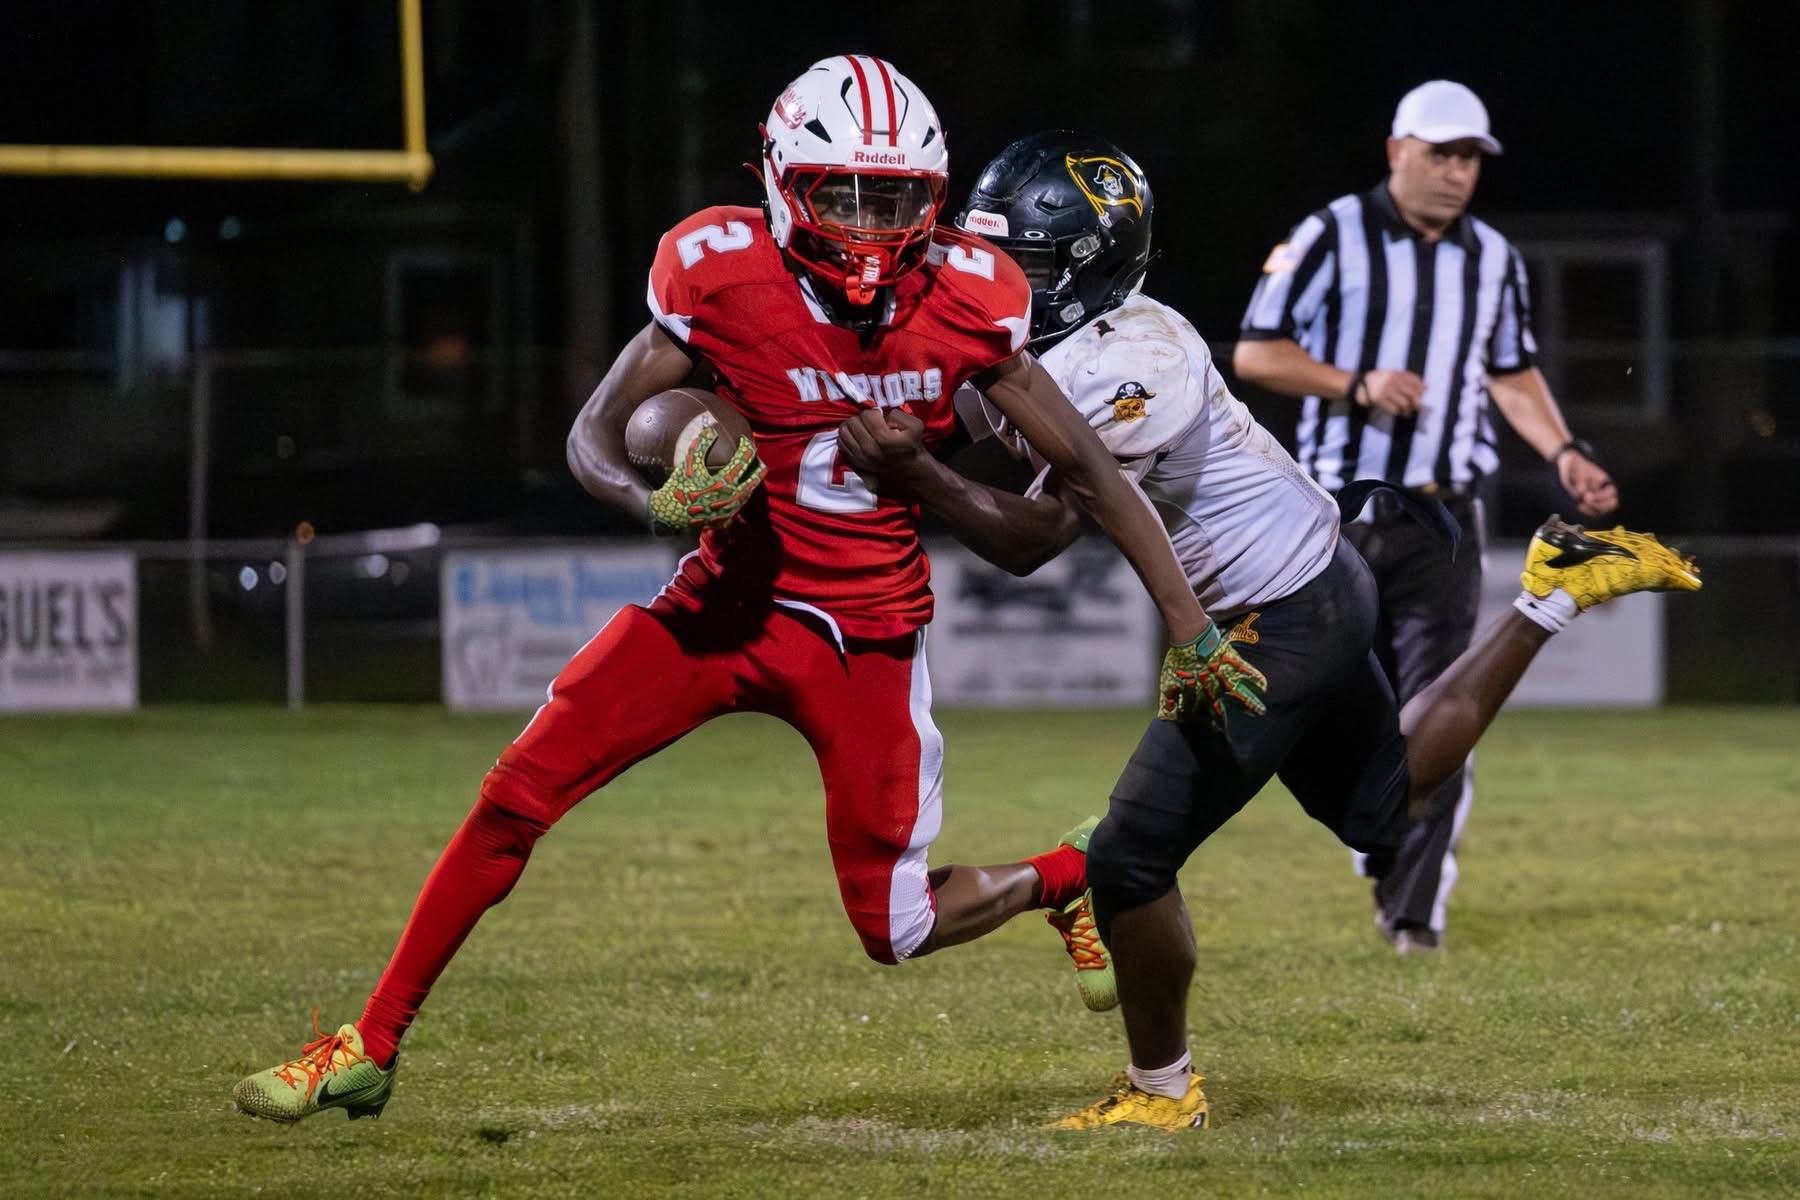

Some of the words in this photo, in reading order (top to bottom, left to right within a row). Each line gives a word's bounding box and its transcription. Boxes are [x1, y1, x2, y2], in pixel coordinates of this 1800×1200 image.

[854, 151, 905, 165] Riddell
[676, 221, 754, 270] 2
[785, 366, 943, 408] WARIORS
